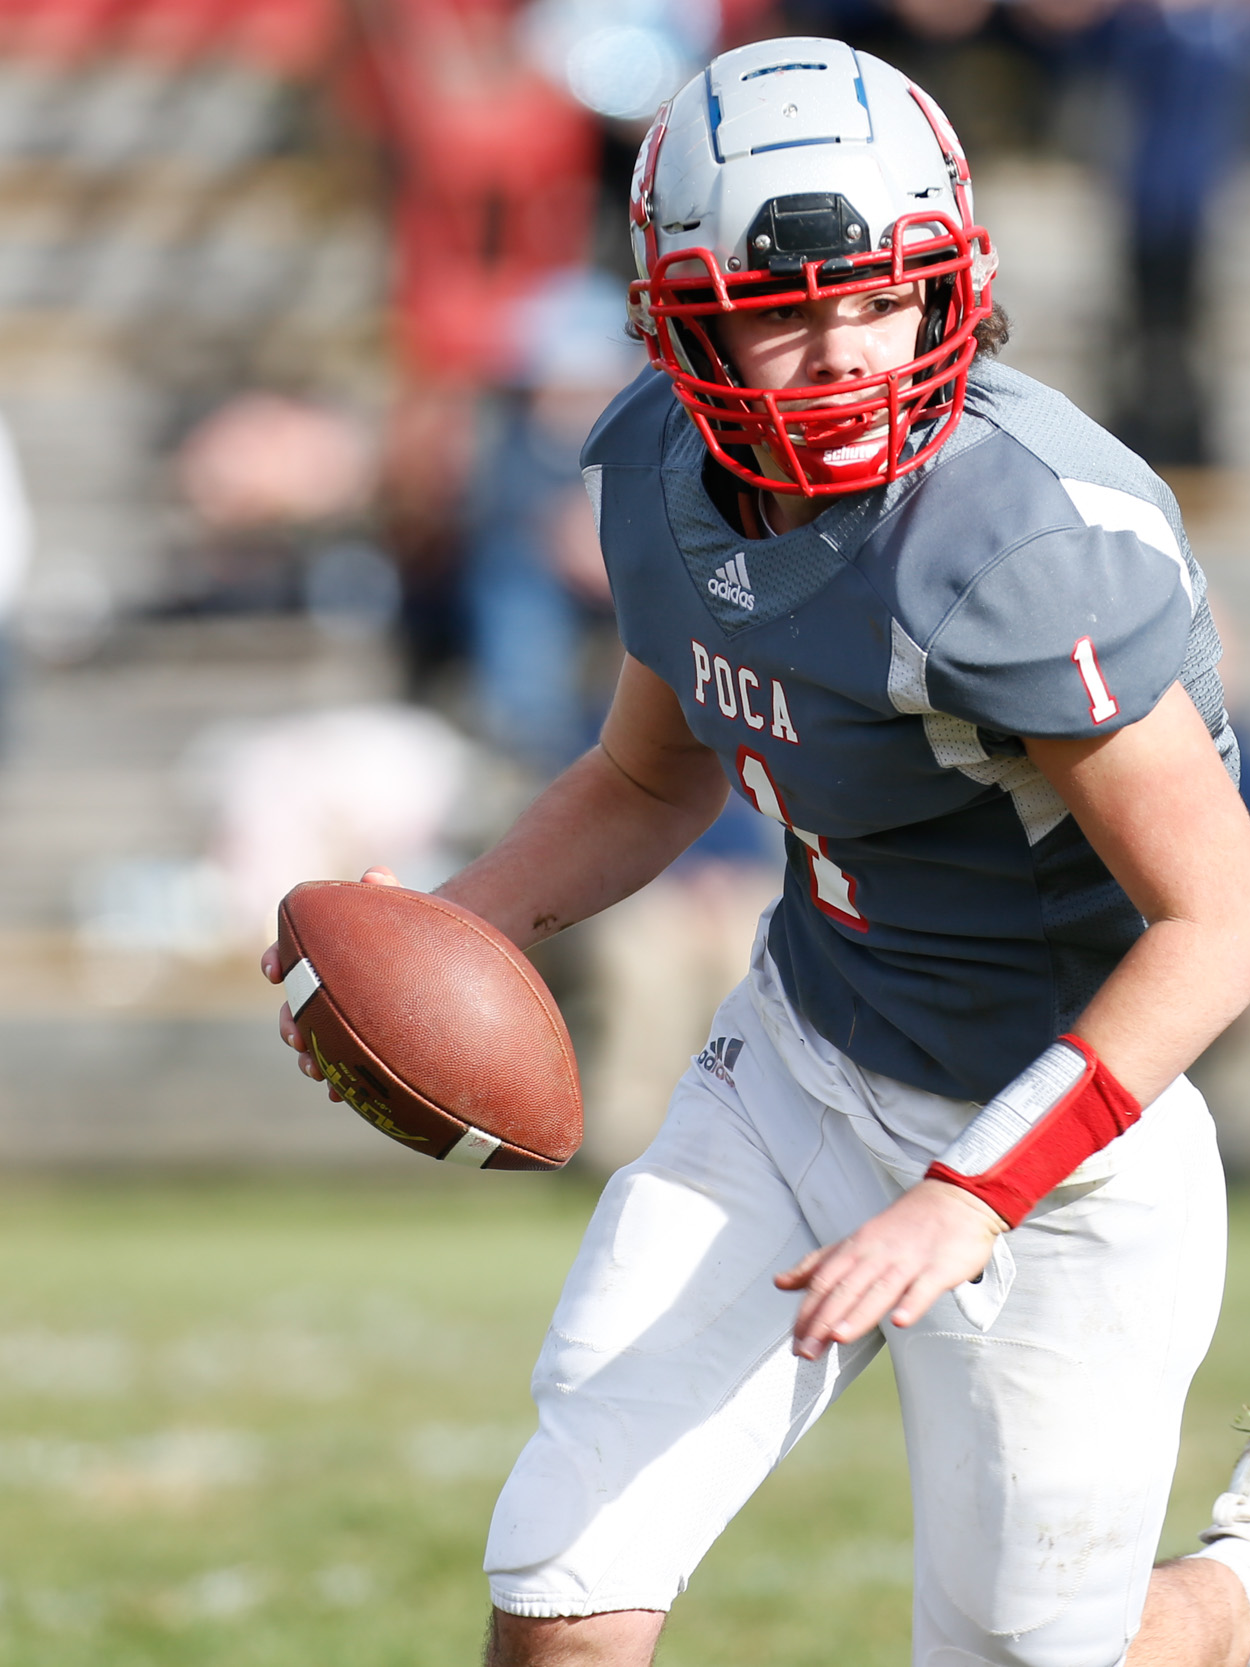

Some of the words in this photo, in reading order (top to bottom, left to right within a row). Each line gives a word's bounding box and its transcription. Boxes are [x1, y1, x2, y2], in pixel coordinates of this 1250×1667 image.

[707, 578, 756, 611] adidas
[691, 637, 801, 745] POCA
[1070, 634, 1121, 726] 1
